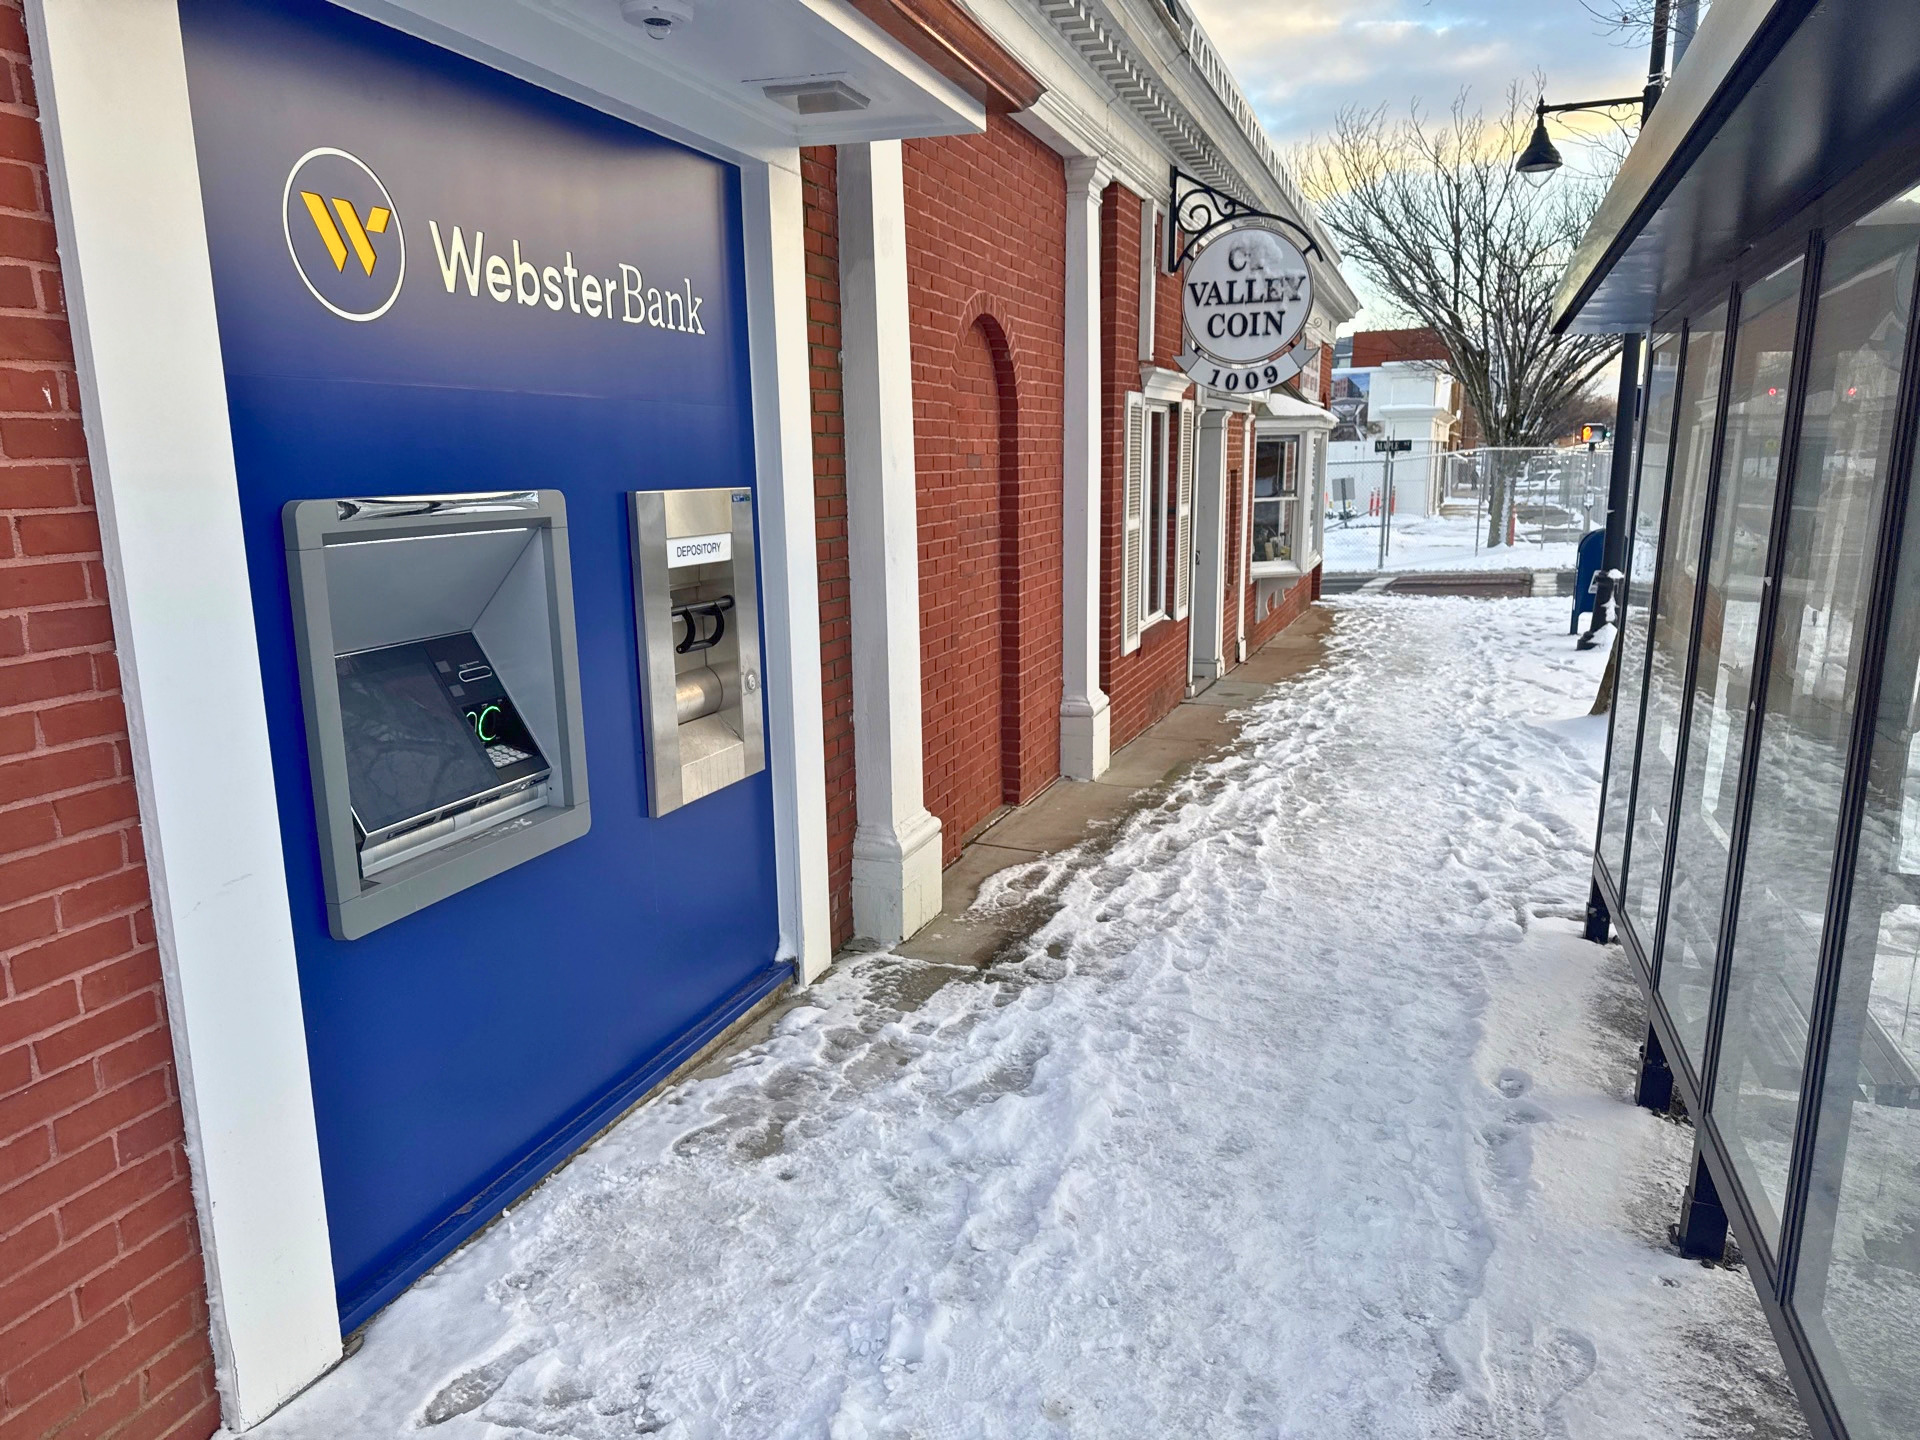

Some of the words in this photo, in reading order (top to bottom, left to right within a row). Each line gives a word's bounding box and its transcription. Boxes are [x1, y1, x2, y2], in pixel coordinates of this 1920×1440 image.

[1228, 246, 1264, 272] C
[1188, 275, 1306, 307] VALLEY
[1207, 310, 1285, 338] COIN
[1208, 365, 1278, 390] 1009
[676, 542, 722, 557] DEPOSITORY
